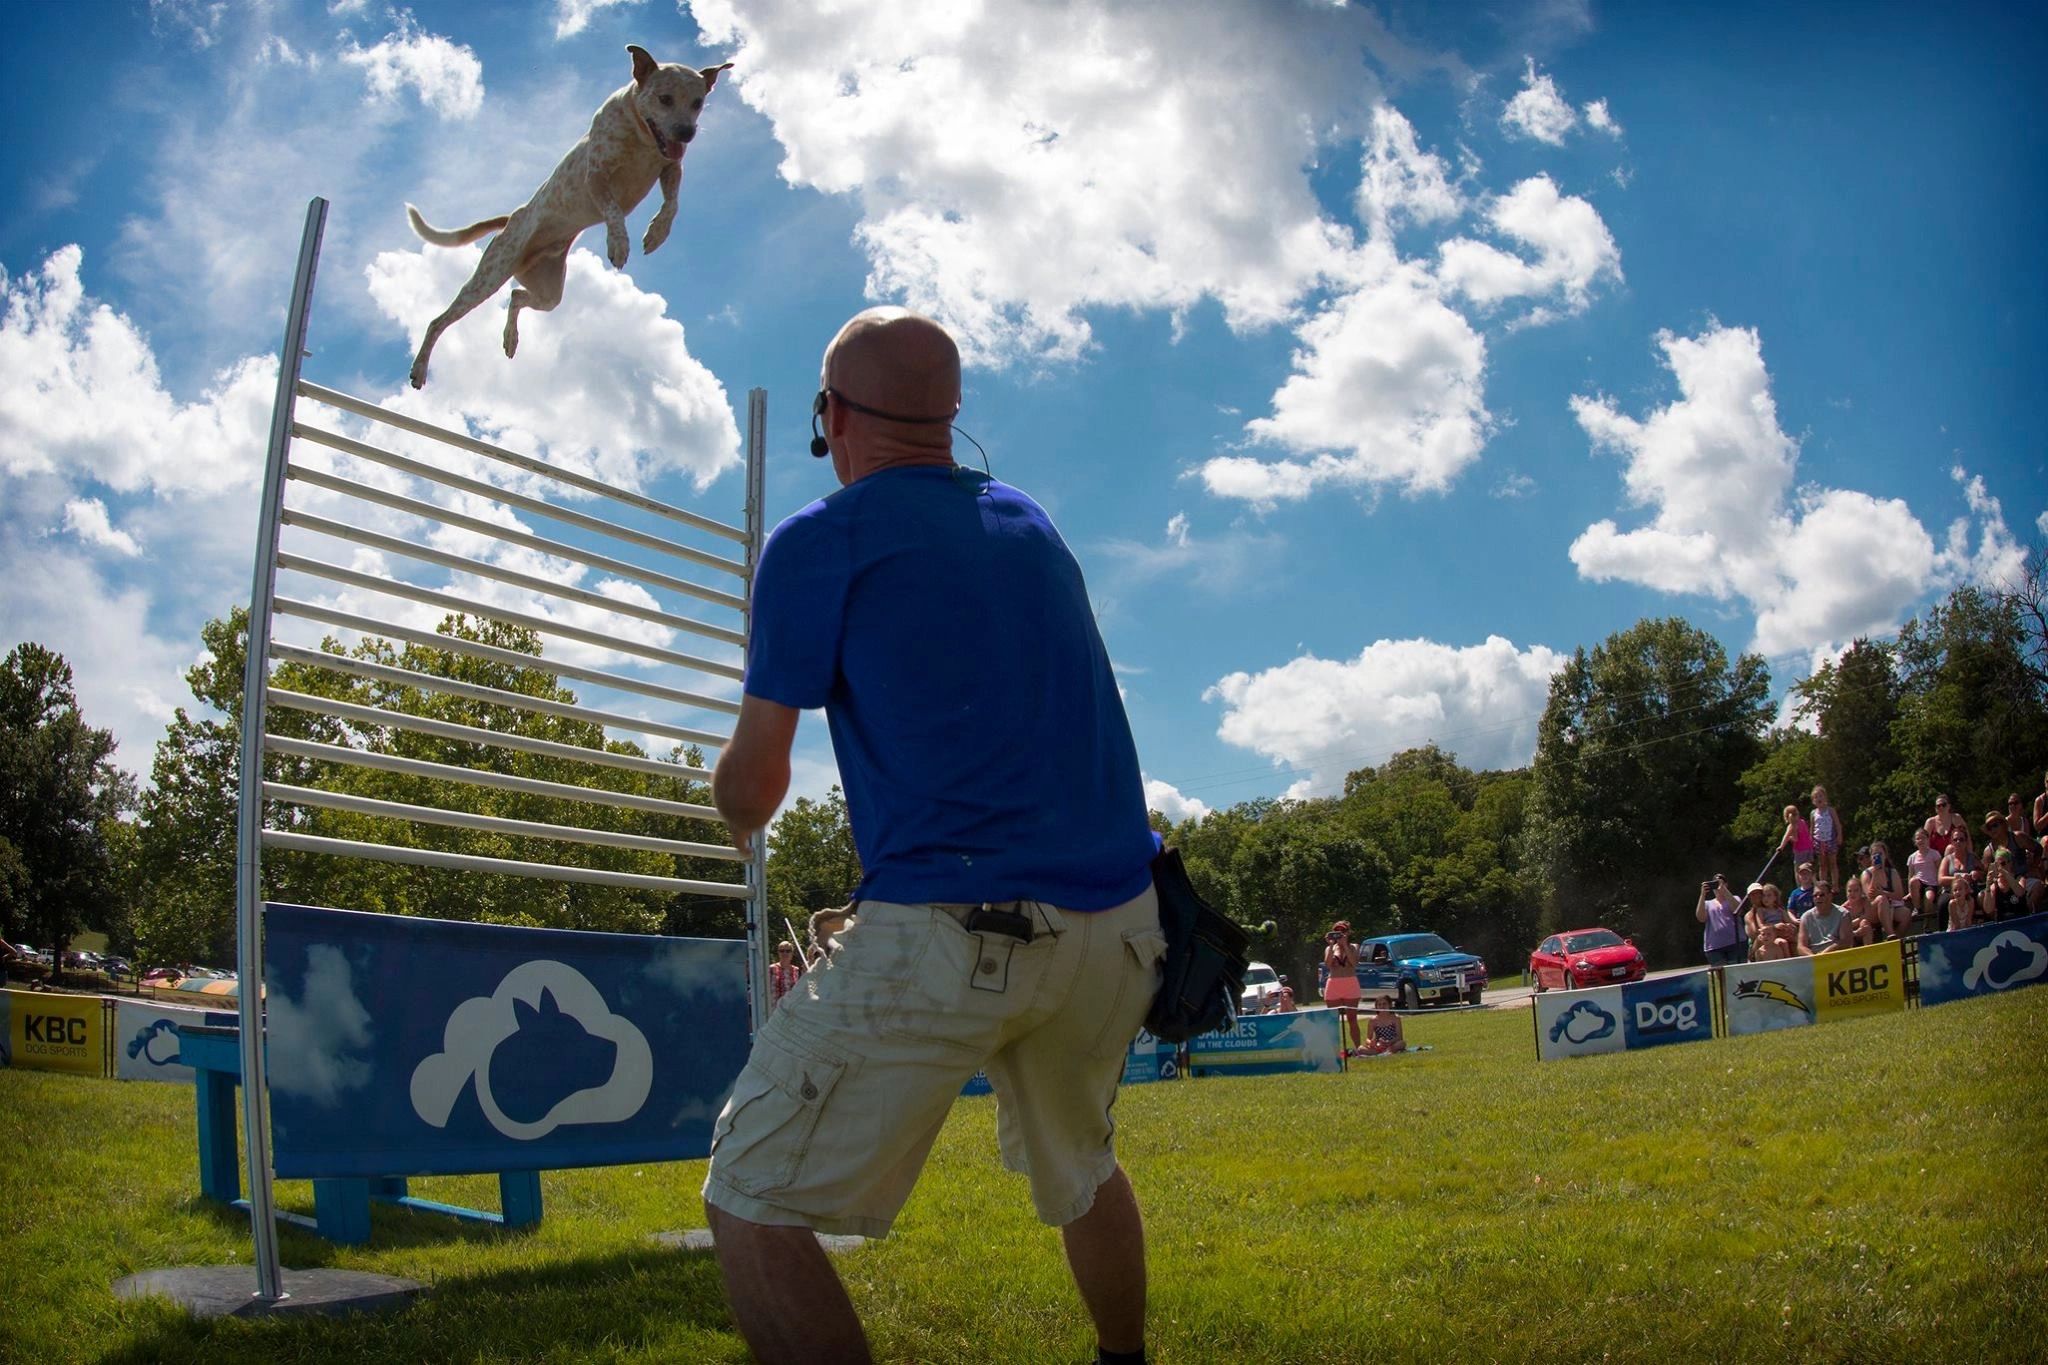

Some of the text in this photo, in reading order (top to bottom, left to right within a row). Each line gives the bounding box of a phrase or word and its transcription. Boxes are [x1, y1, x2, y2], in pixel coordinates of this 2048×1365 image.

[1828, 964, 1889, 998] KBC
[1852, 990, 1890, 1005] SPORTS
[1635, 1000, 1699, 1031] Dog
[25, 1014, 87, 1045] KBC
[25, 1042, 88, 1058] DOG SPORTS
[1197, 1039, 1258, 1049] IN THE CLOUDS
